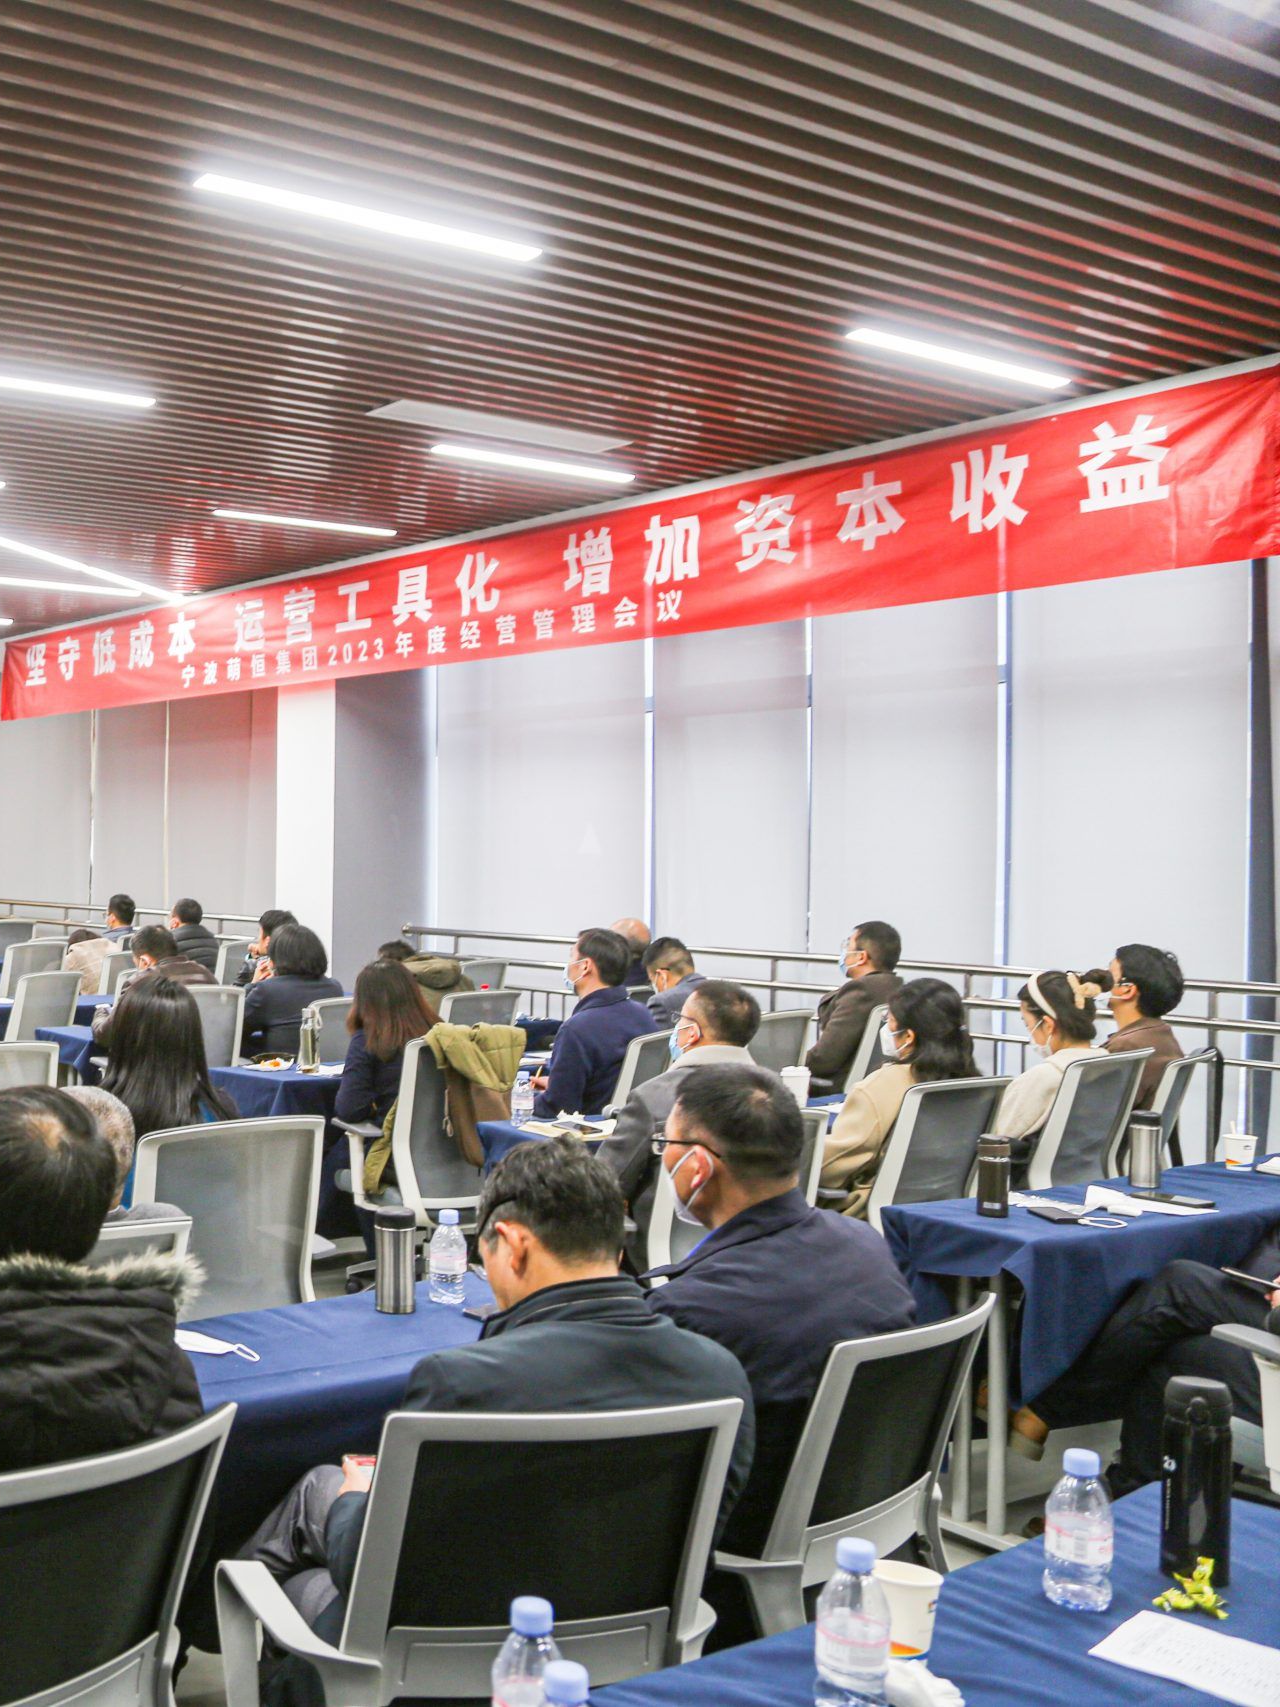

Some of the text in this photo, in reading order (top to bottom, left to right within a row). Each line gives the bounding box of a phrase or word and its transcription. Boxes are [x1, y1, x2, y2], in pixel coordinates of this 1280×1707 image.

[24, 414, 1171, 687] 坚守低成本 运营工具化 增加资本收益
